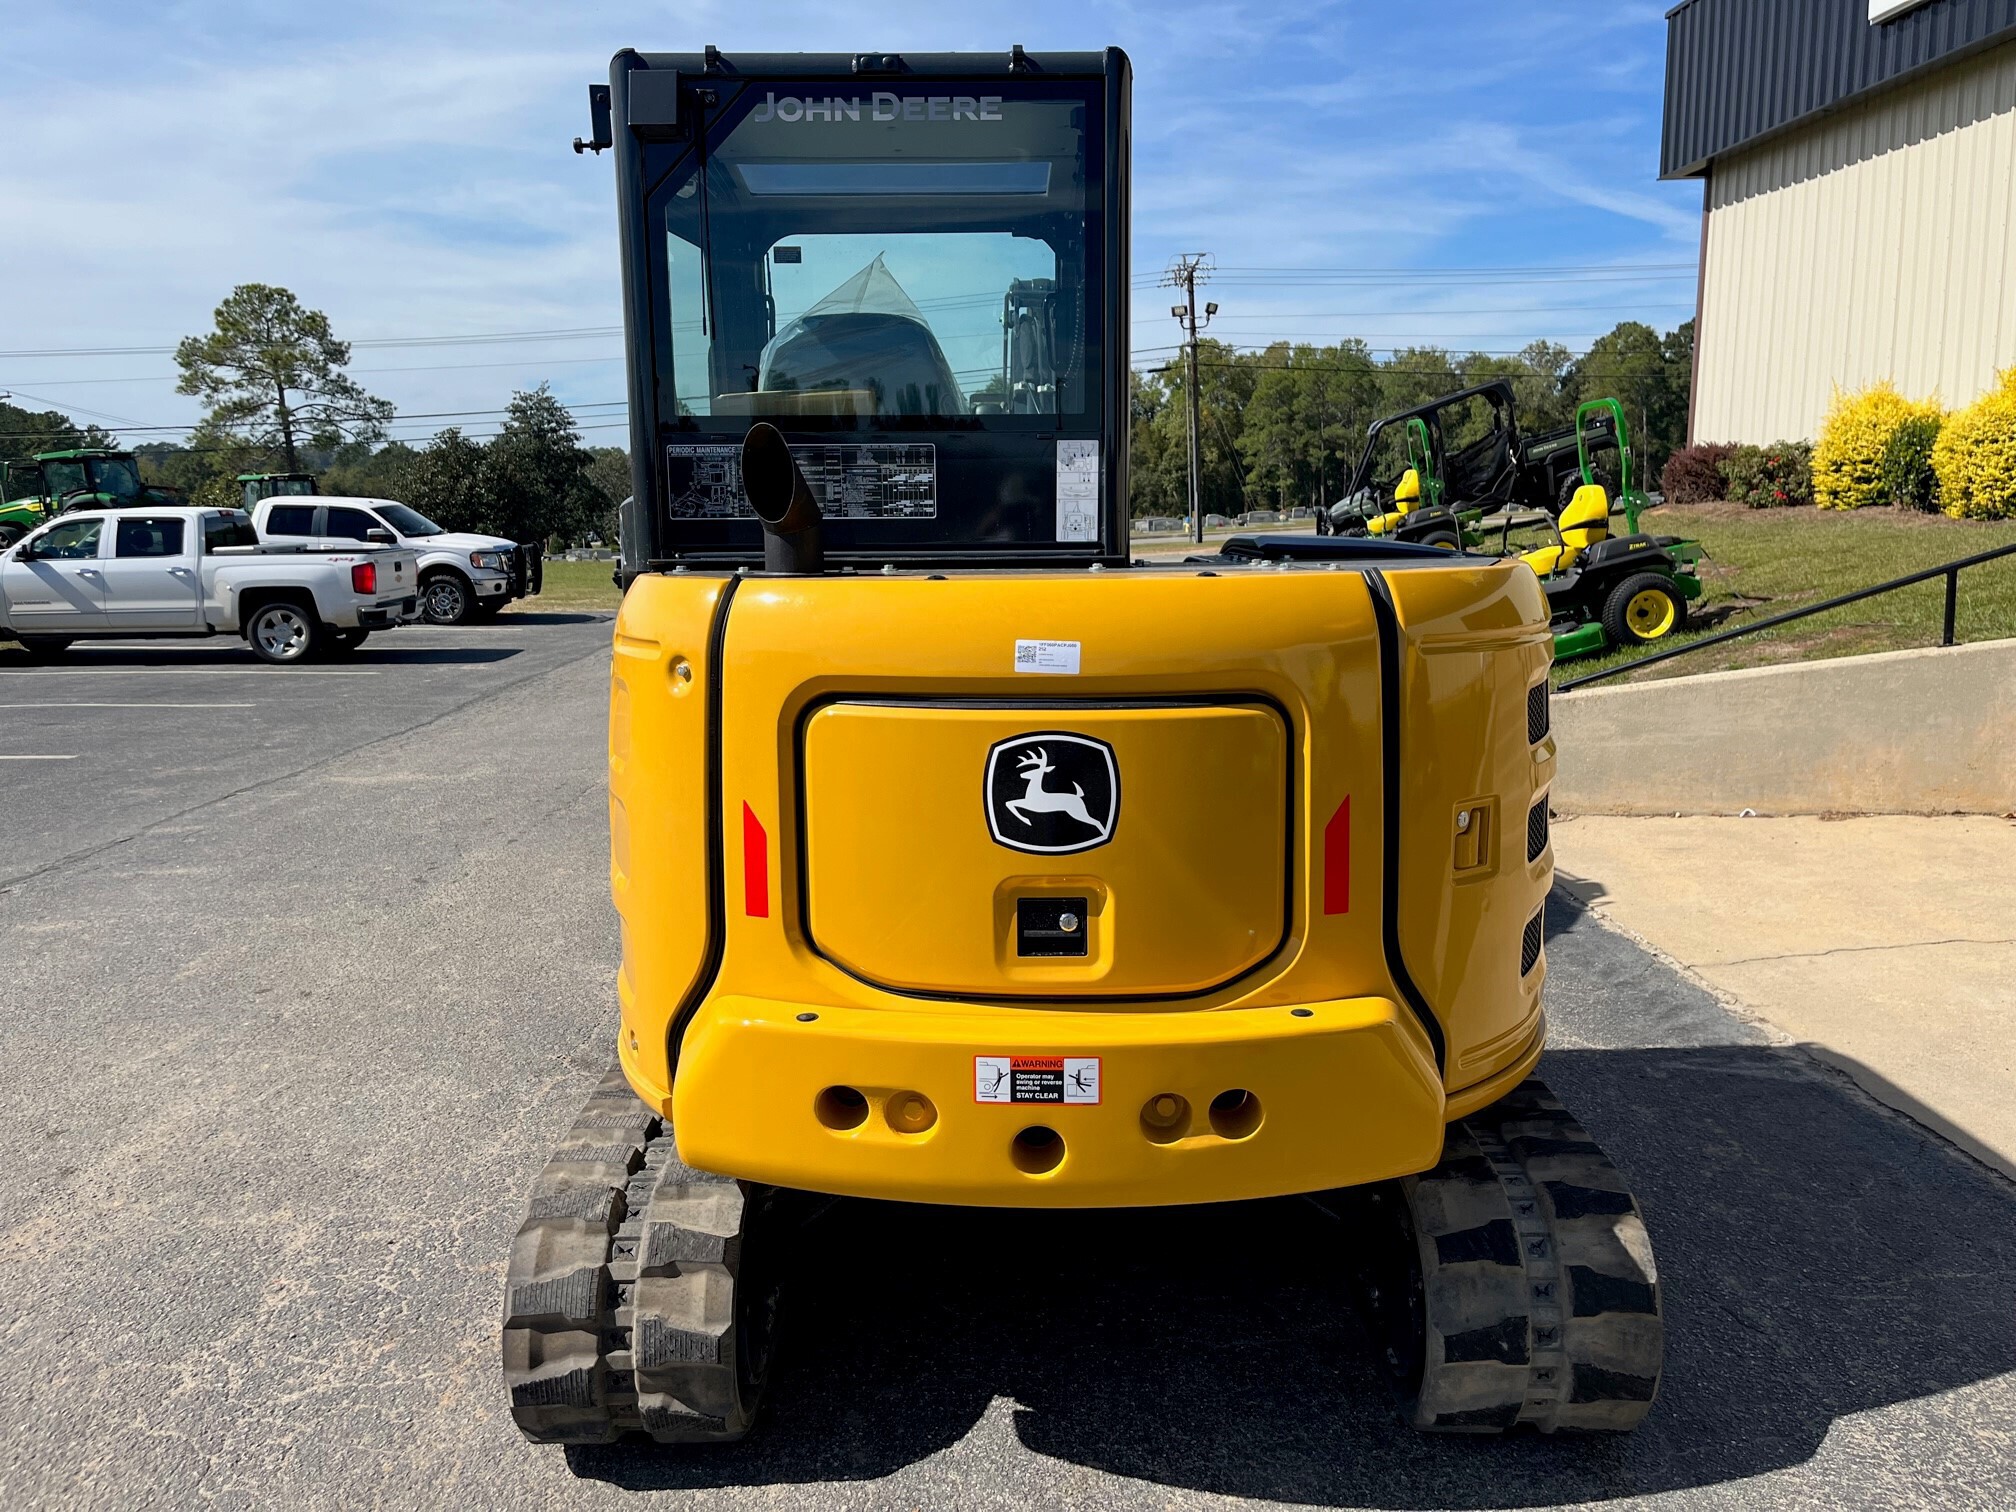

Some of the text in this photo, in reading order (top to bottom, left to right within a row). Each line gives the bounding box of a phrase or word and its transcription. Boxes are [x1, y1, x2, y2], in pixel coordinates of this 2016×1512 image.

[754, 91, 1003, 123] JOHN DEERE
[668, 446, 736, 454] PERIODIC MAINTENANCE
[1020, 1059, 1063, 1068] WARNING
